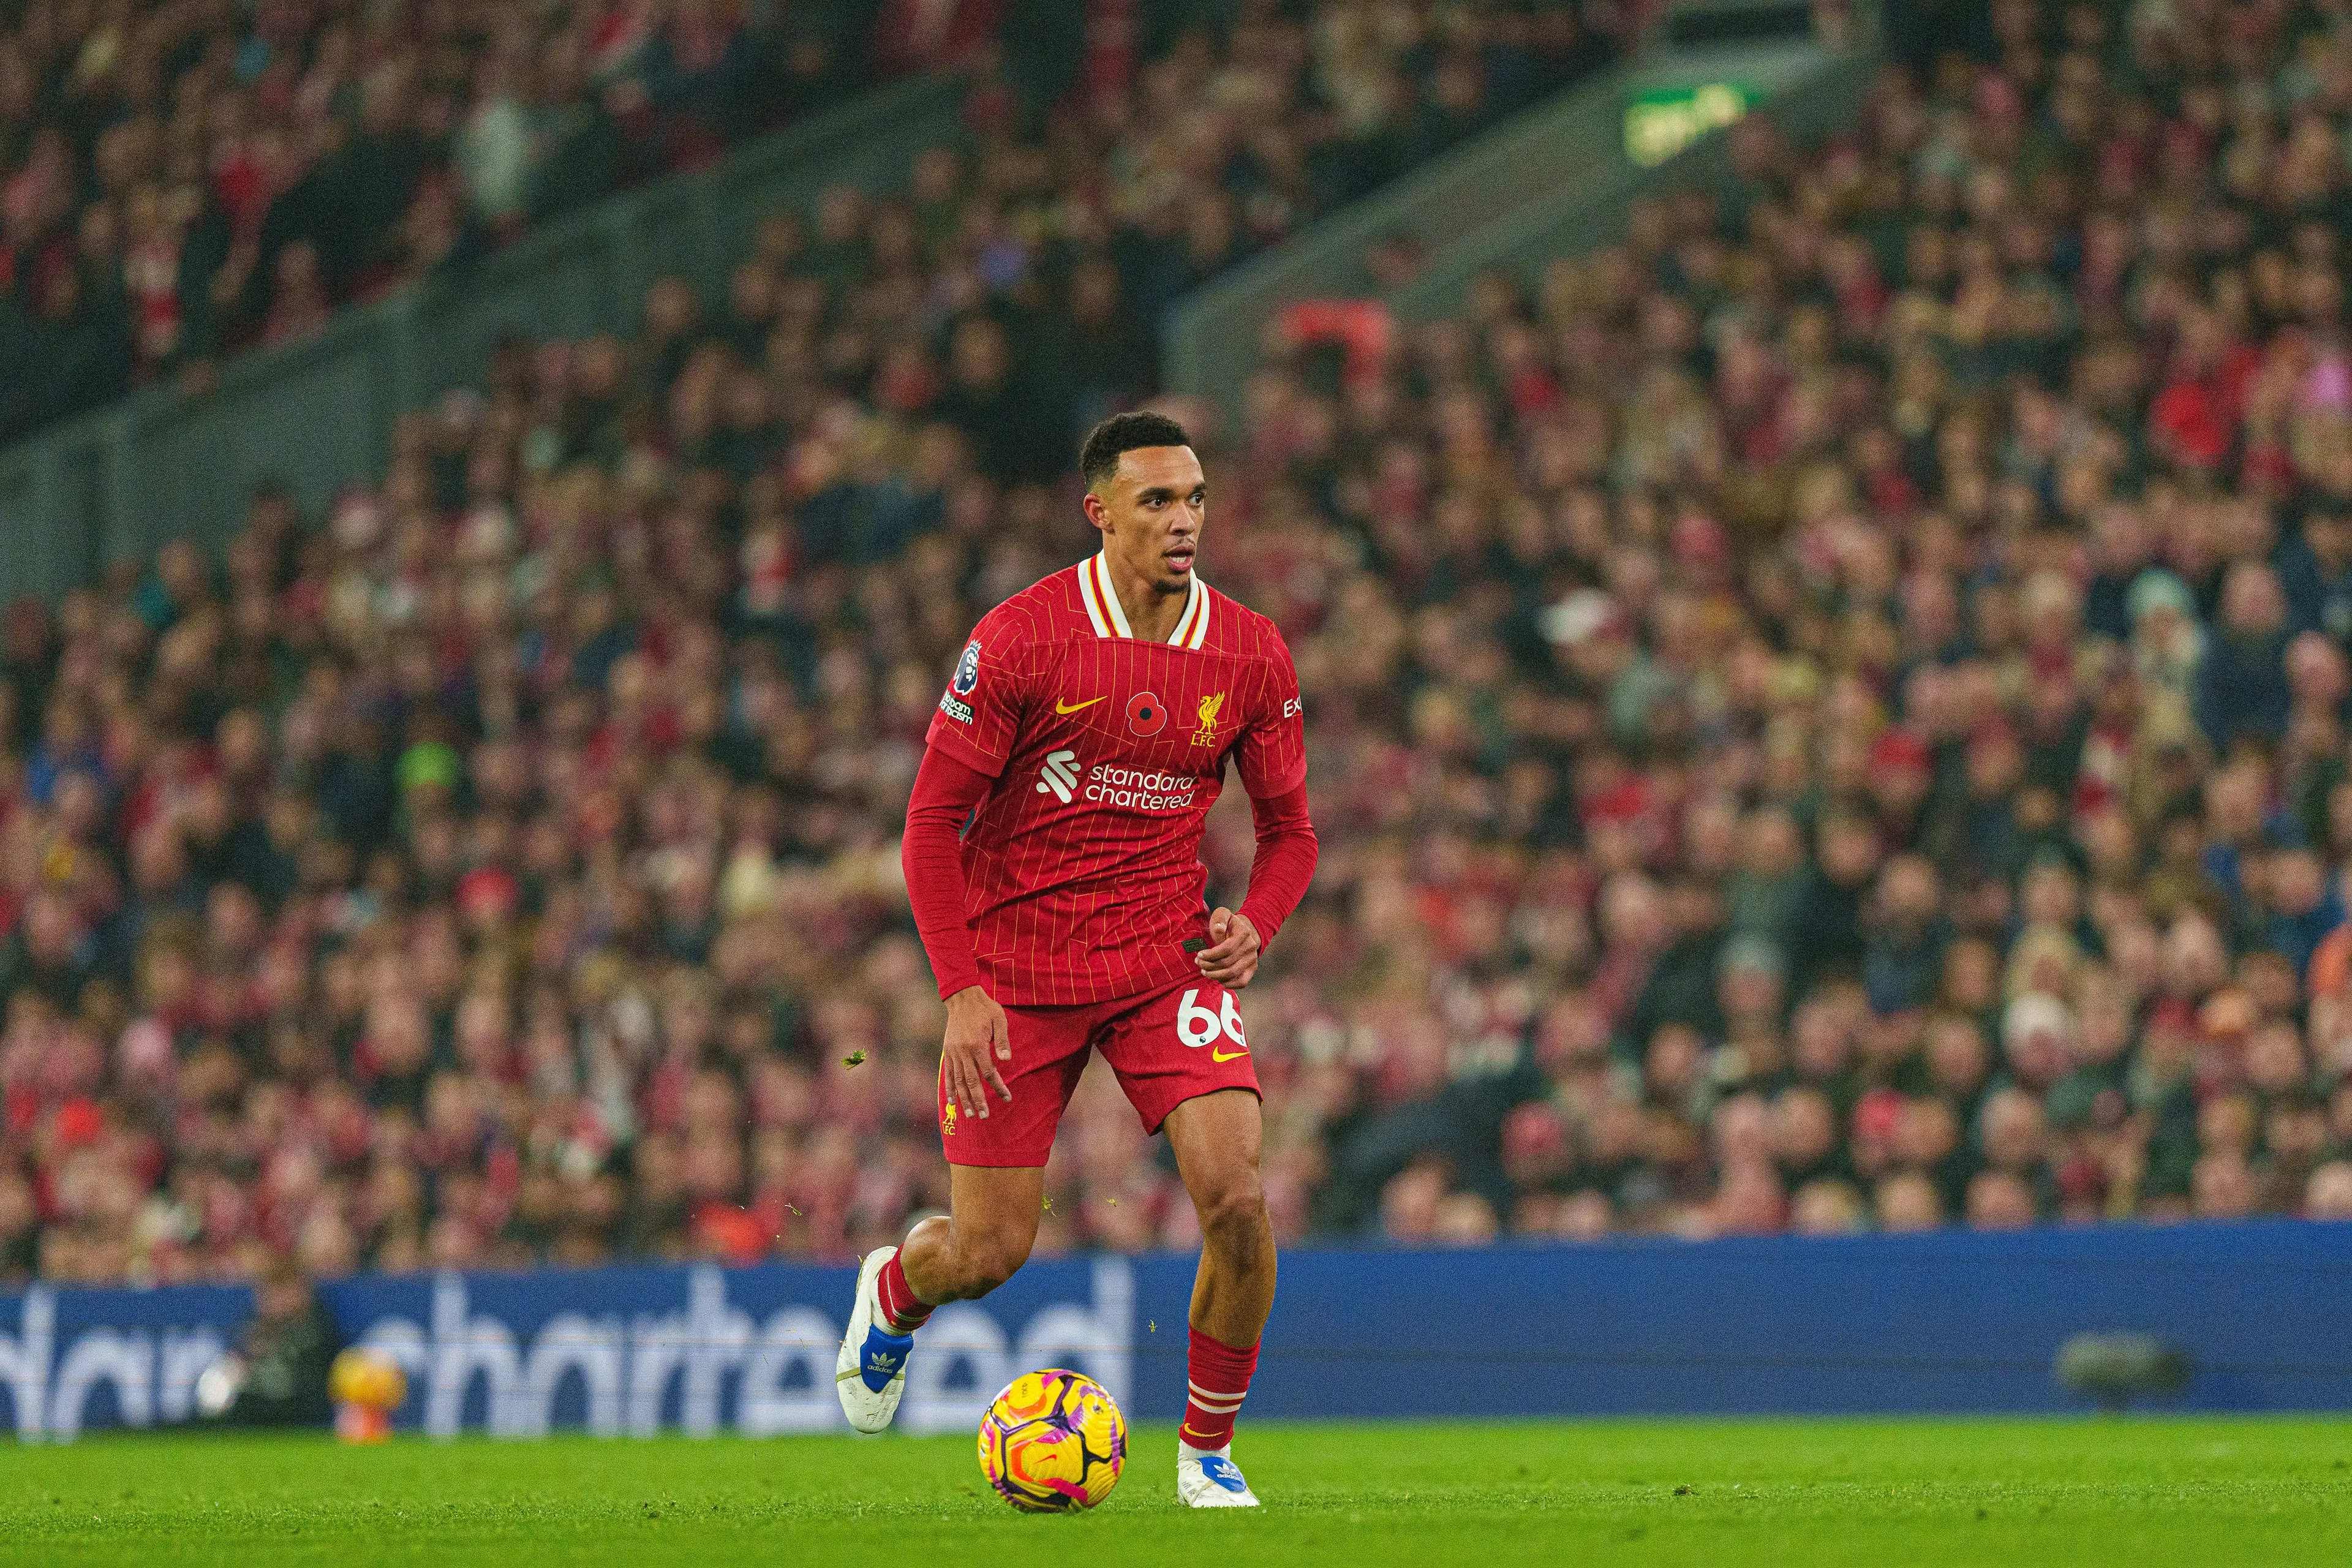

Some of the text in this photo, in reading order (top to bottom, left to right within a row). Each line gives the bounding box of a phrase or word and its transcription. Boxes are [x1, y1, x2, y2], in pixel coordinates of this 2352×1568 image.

[945, 705, 973, 725] racism
[1284, 695, 1302, 718] Ex
[1191, 734, 1215, 747] L.F.C.
[1090, 764, 1197, 791] standard
[1085, 783, 1195, 810] chartered
[1177, 989, 1248, 1048] 66
